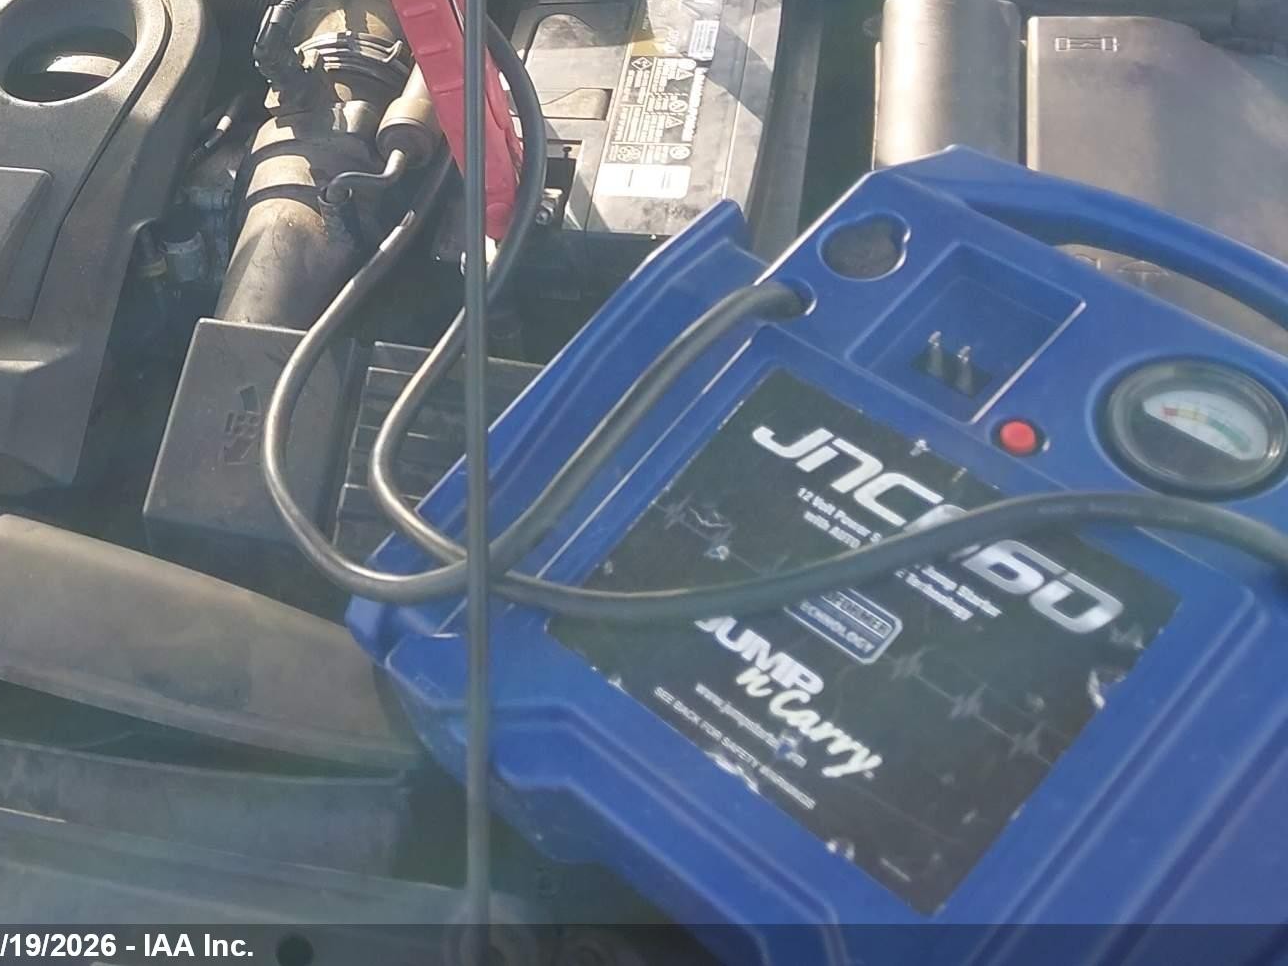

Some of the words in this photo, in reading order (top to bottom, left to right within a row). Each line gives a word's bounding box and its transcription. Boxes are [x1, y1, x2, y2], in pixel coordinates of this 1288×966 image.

[797, 487, 814, 502] 12
[833, 509, 872, 537] Power
[799, 600, 875, 653] ECHNOLOGY
[654, 686, 674, 705] SEE
[672, 700, 701, 725] BACK
[700, 720, 723, 741] FOR
[721, 736, 760, 768] SAFETY
[769, 689, 883, 778] Carry
